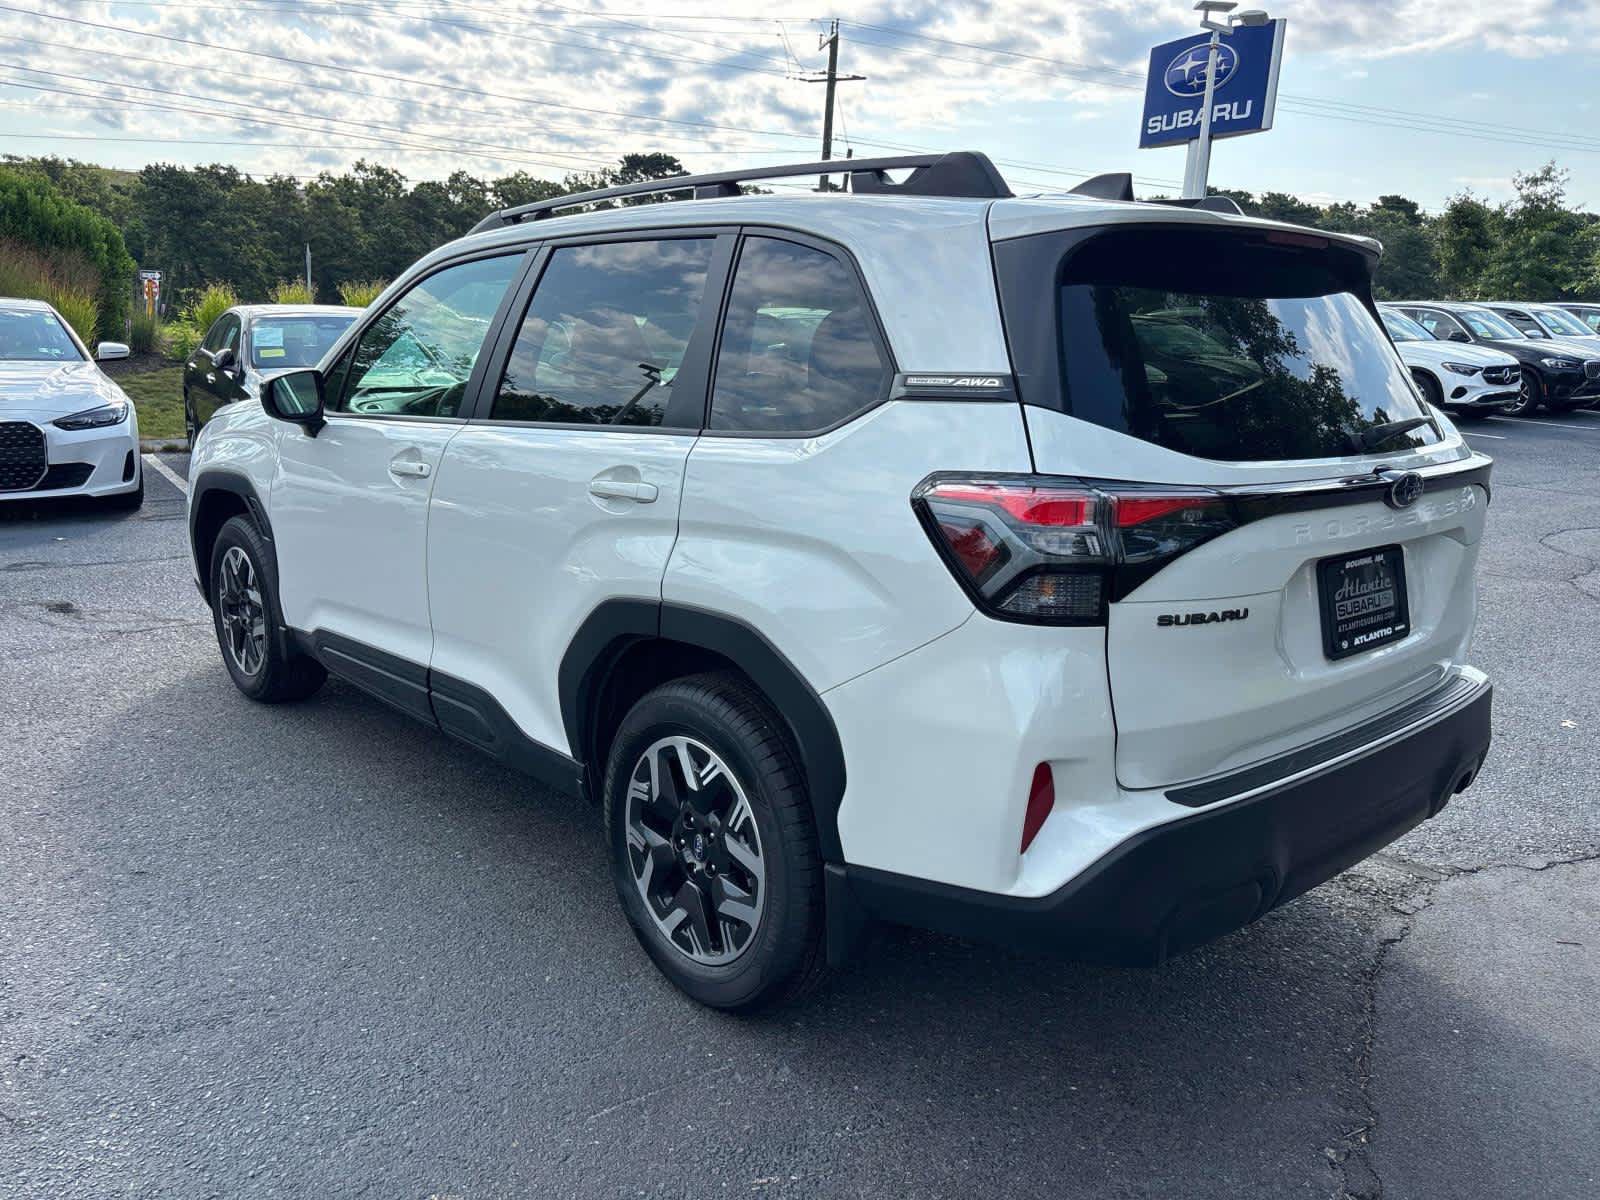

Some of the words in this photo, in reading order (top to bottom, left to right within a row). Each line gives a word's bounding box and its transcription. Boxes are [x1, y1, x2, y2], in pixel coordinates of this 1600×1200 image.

[1147, 100, 1252, 134] SUBARU
[953, 377, 1000, 387] AWD
[1335, 572, 1392, 601] Atlantic
[1337, 593, 1381, 617] SUBARU
[1157, 607, 1249, 626] SUBARU
[1354, 627, 1392, 646] ATLANTIC
